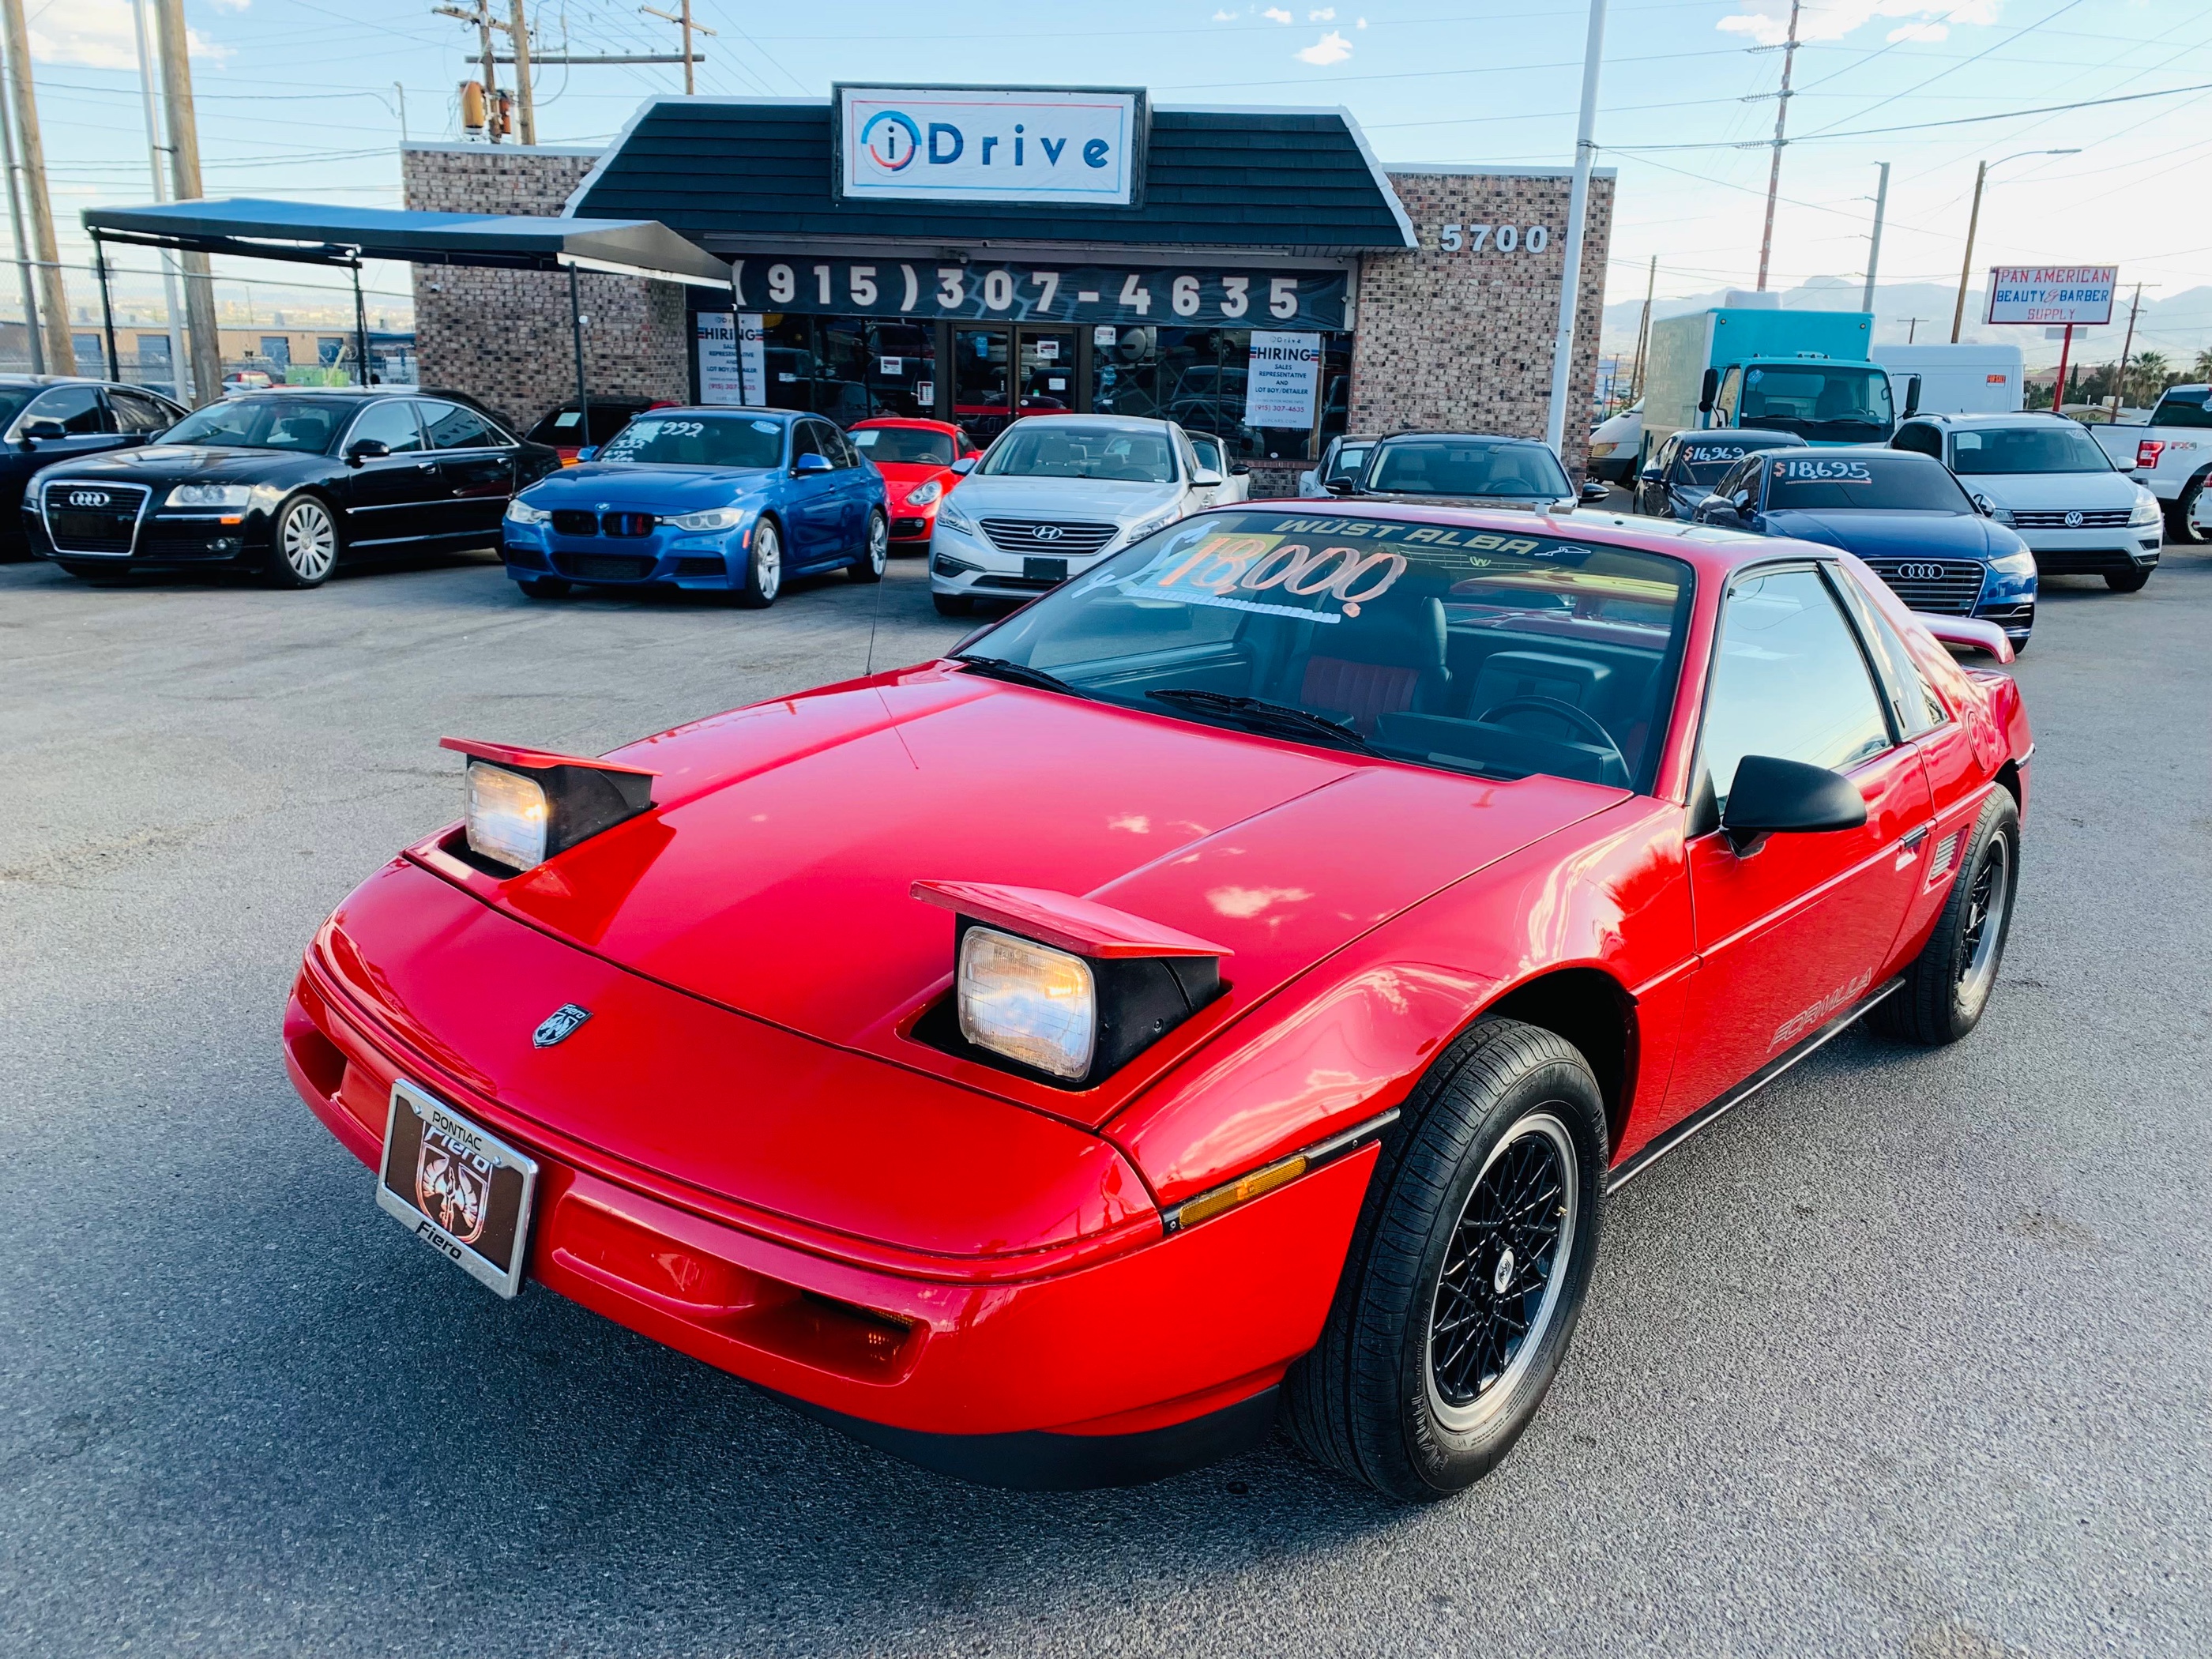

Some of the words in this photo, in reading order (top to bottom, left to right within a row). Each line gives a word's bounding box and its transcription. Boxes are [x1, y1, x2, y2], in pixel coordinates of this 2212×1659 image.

[1440, 224, 1548, 254] 5700
[2000, 269, 2030, 283] PAN
[2034, 269, 2112, 283] AMERICAN
[1996, 290, 2045, 302] BEAUTY
[2060, 289, 2109, 302] BARBER
[2027, 308, 2077, 320] SUPPLY
[1257, 347, 1311, 362] HIRING
[1272, 518, 1405, 541] WÜST
[1410, 529, 1540, 555] ALBA
[564, 1004, 587, 1019] Fiero
[1766, 966, 1872, 1054] FORMULA
[431, 1111, 483, 1152] PONTIAC
[415, 1221, 462, 1260] Fiero
